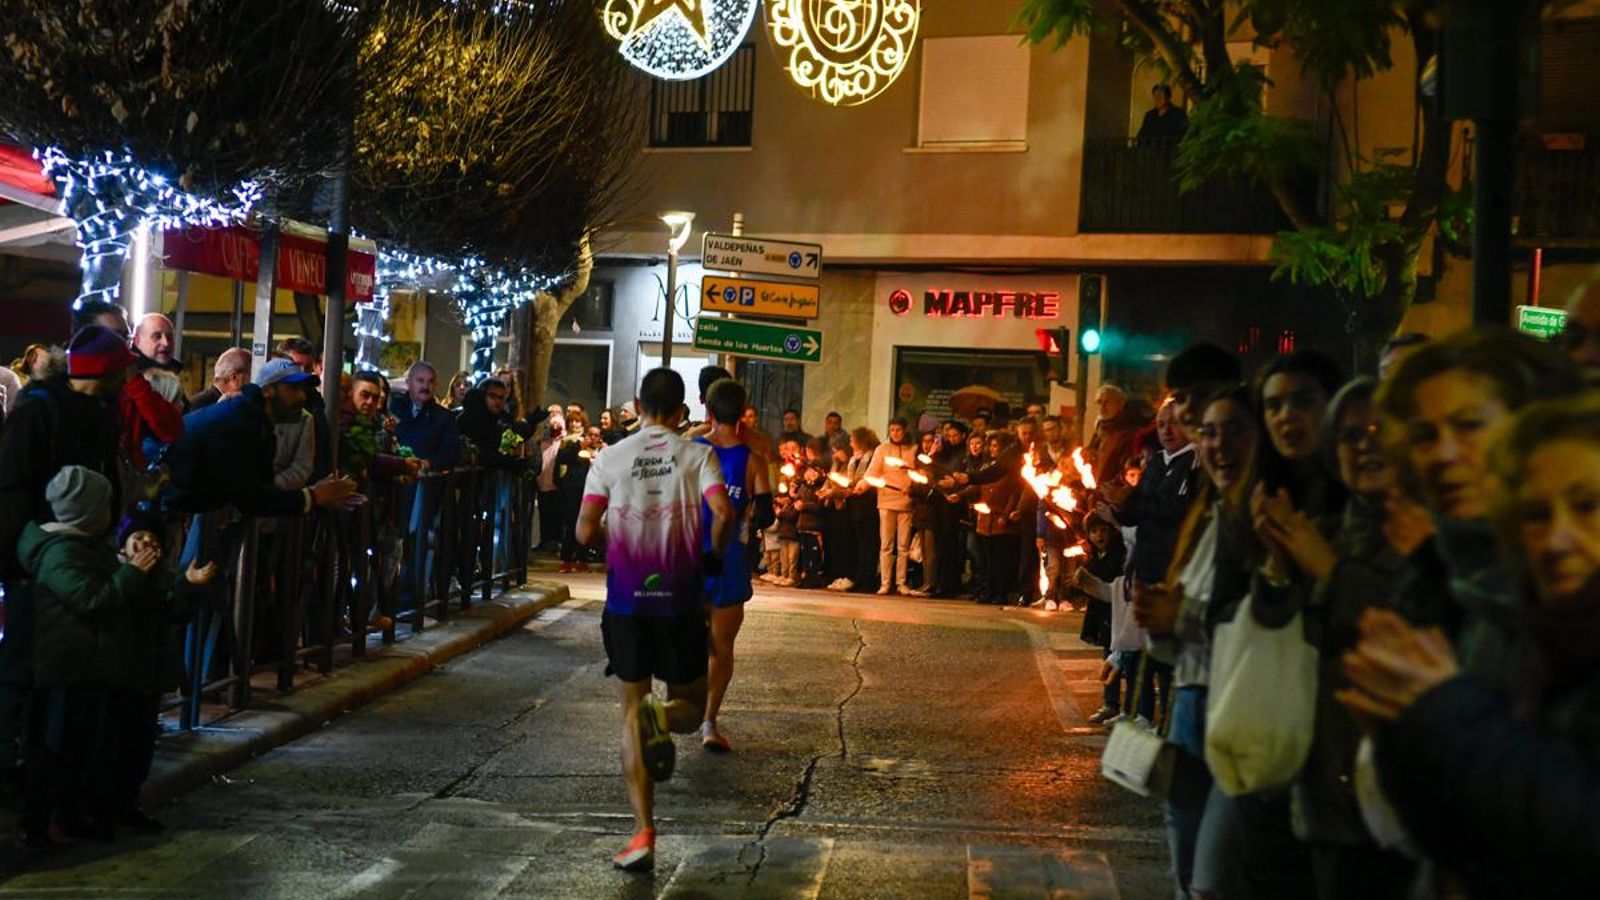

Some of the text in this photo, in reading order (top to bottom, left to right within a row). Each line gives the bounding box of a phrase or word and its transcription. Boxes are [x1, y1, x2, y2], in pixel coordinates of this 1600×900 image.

[708, 240, 764, 255] VALDEPEÑAS
[706, 254, 743, 267] DE JAÉN
[289, 247, 326, 289] VENECI
[924, 289, 1059, 319] MAPFRE
[699, 323, 719, 332] calle
[723, 340, 734, 348] de
[735, 341, 748, 349] los
